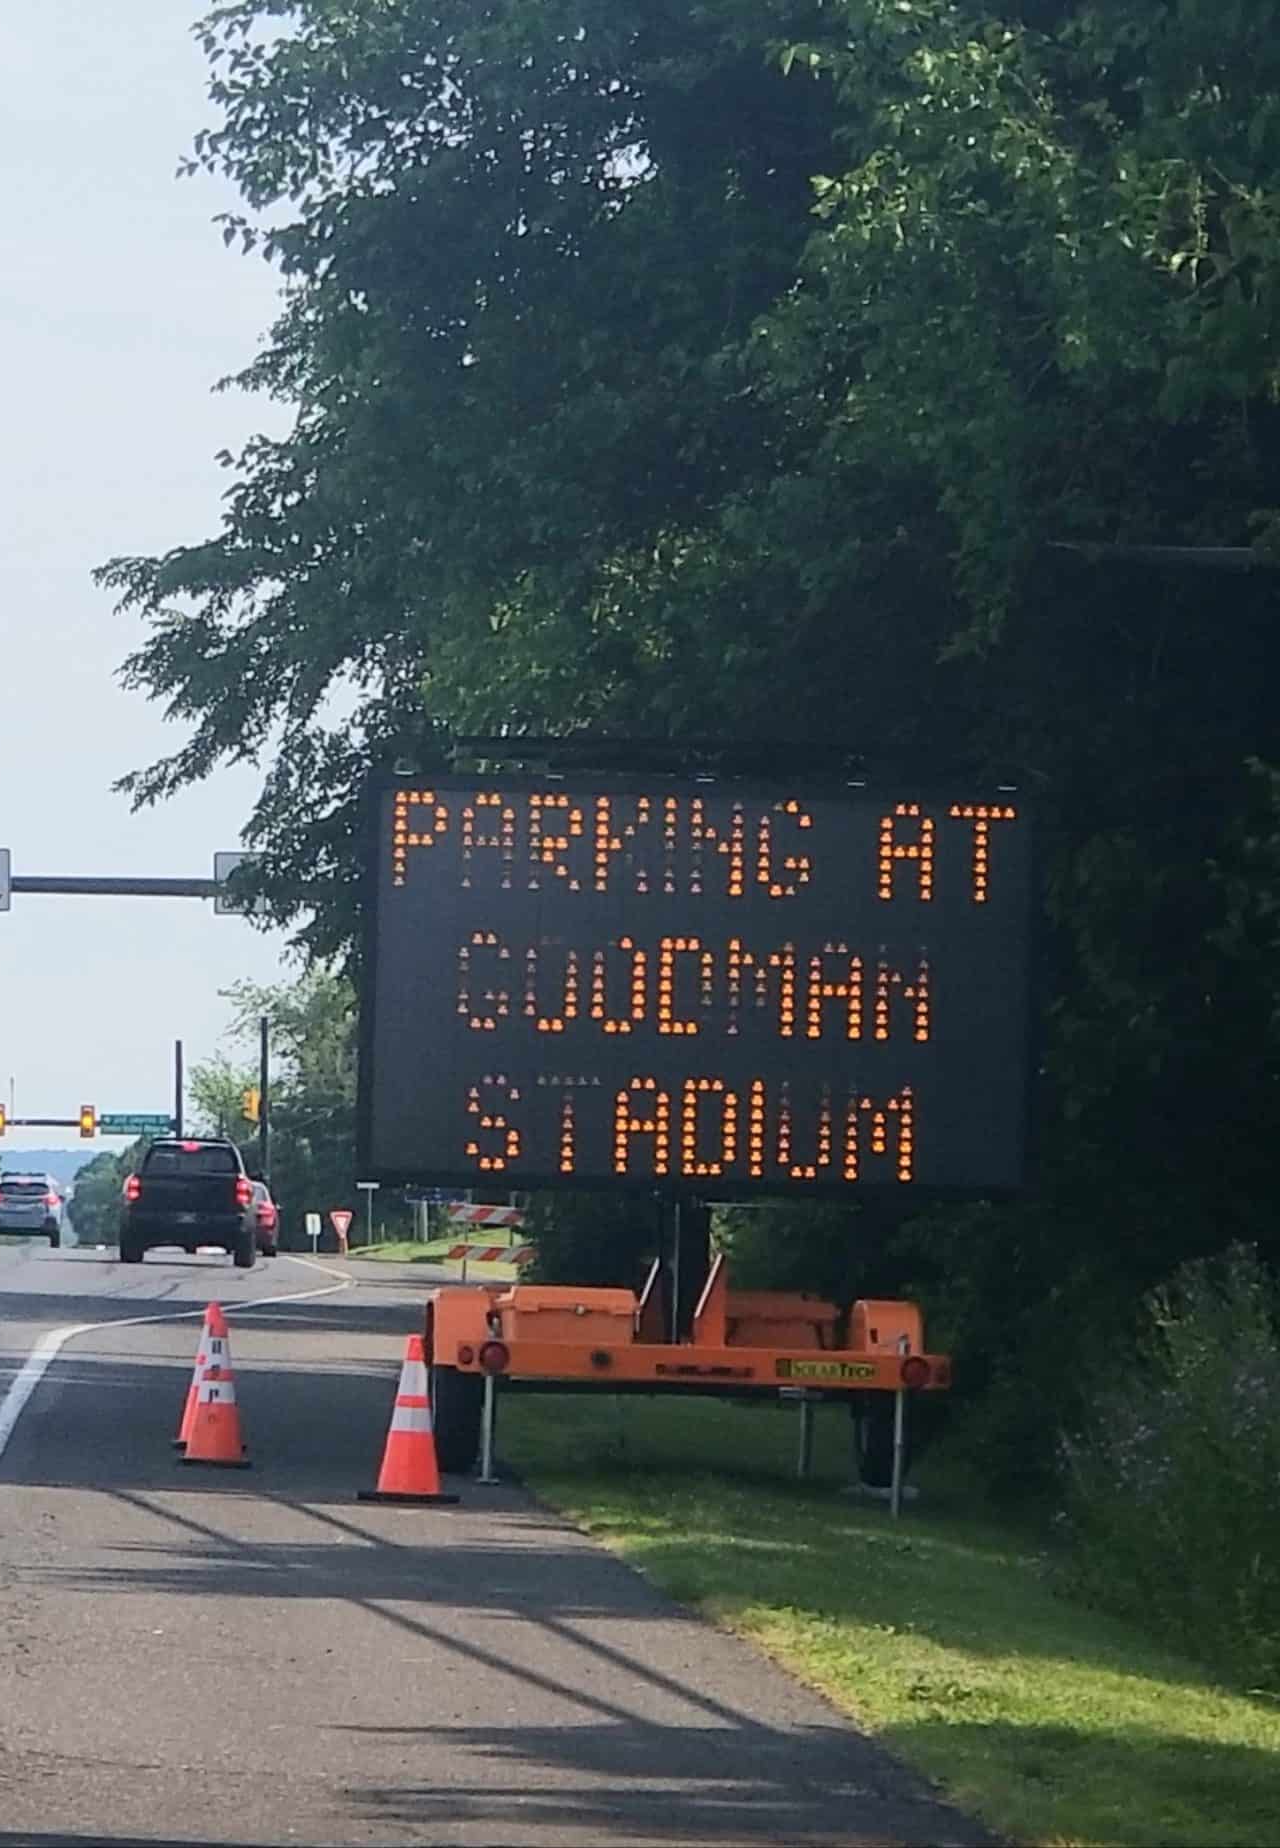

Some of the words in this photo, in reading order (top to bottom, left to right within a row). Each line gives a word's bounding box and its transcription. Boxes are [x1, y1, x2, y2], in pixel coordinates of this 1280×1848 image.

[393, 789, 812, 896] PARKING
[878, 801, 1017, 902] AT
[456, 932, 930, 1041] GOODMAN
[464, 1074, 914, 1182] STADIUM
